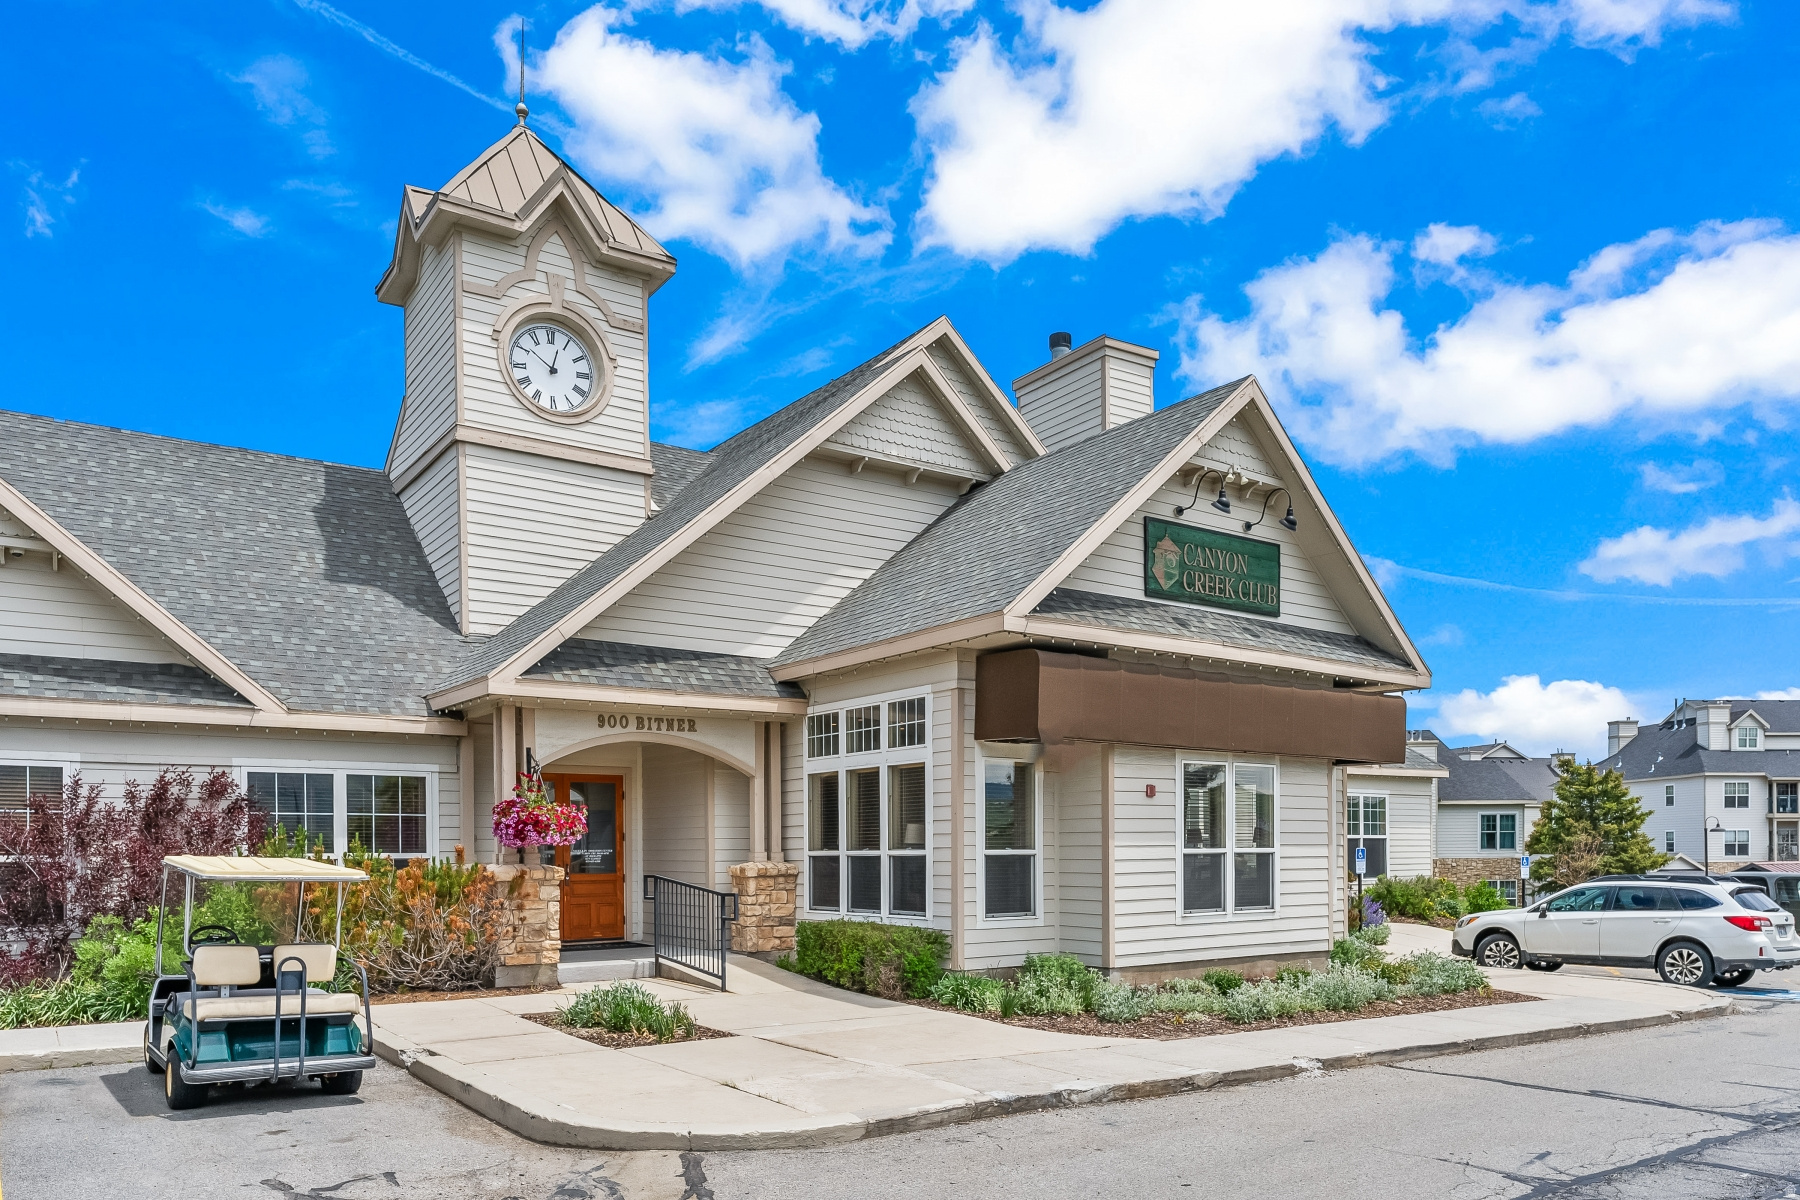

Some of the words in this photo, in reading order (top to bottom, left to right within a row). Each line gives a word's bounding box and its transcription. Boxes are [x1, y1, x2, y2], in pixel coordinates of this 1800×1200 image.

[528, 331, 540, 347] XI
[546, 330, 555, 345] XII
[562, 339, 571, 351] I
[516, 342, 530, 355] X
[513, 360, 526, 370] IX
[572, 355, 585, 364] II
[576, 371, 590, 380] III
[550, 395, 557, 410] VI
[564, 394, 575, 409] V
[1183, 543, 1248, 575] CANYON
[1183, 570, 1236, 599] CREEK
[1238, 580, 1277, 606] CLUB
[597, 714, 629, 729] 900
[635, 716, 698, 732] BITNER
